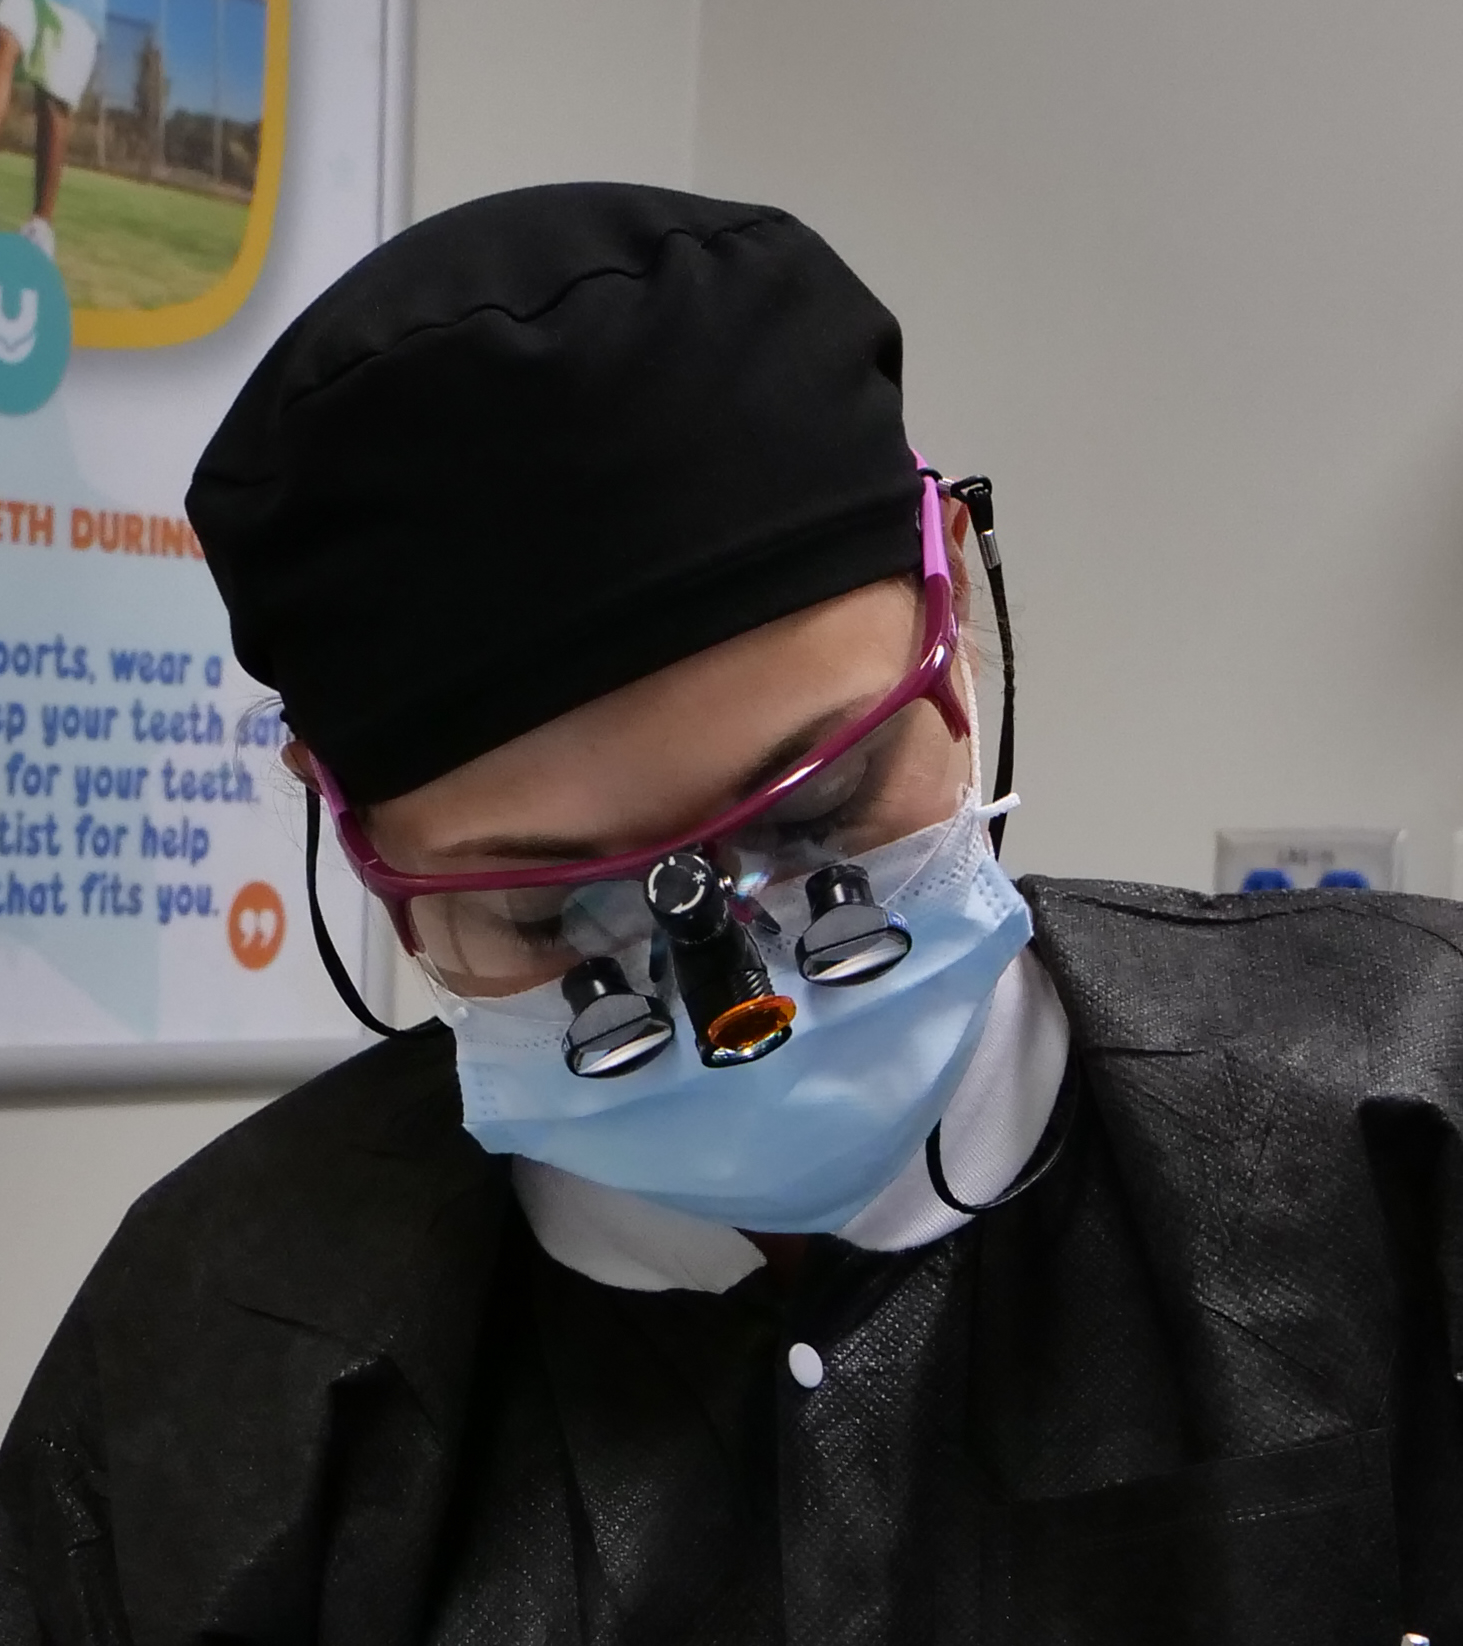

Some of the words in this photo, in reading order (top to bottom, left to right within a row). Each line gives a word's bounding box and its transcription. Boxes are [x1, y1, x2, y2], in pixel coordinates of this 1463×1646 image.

[111, 649, 191, 686] wear
[205, 653, 223, 688] a
[43, 704, 118, 748] your
[132, 700, 224, 745] teeth
[6, 750, 60, 800] for
[73, 765, 148, 810] your
[75, 811, 128, 858] for
[140, 818, 209, 864] help
[79, 870, 143, 919] fits
[157, 885, 219, 925] you.
